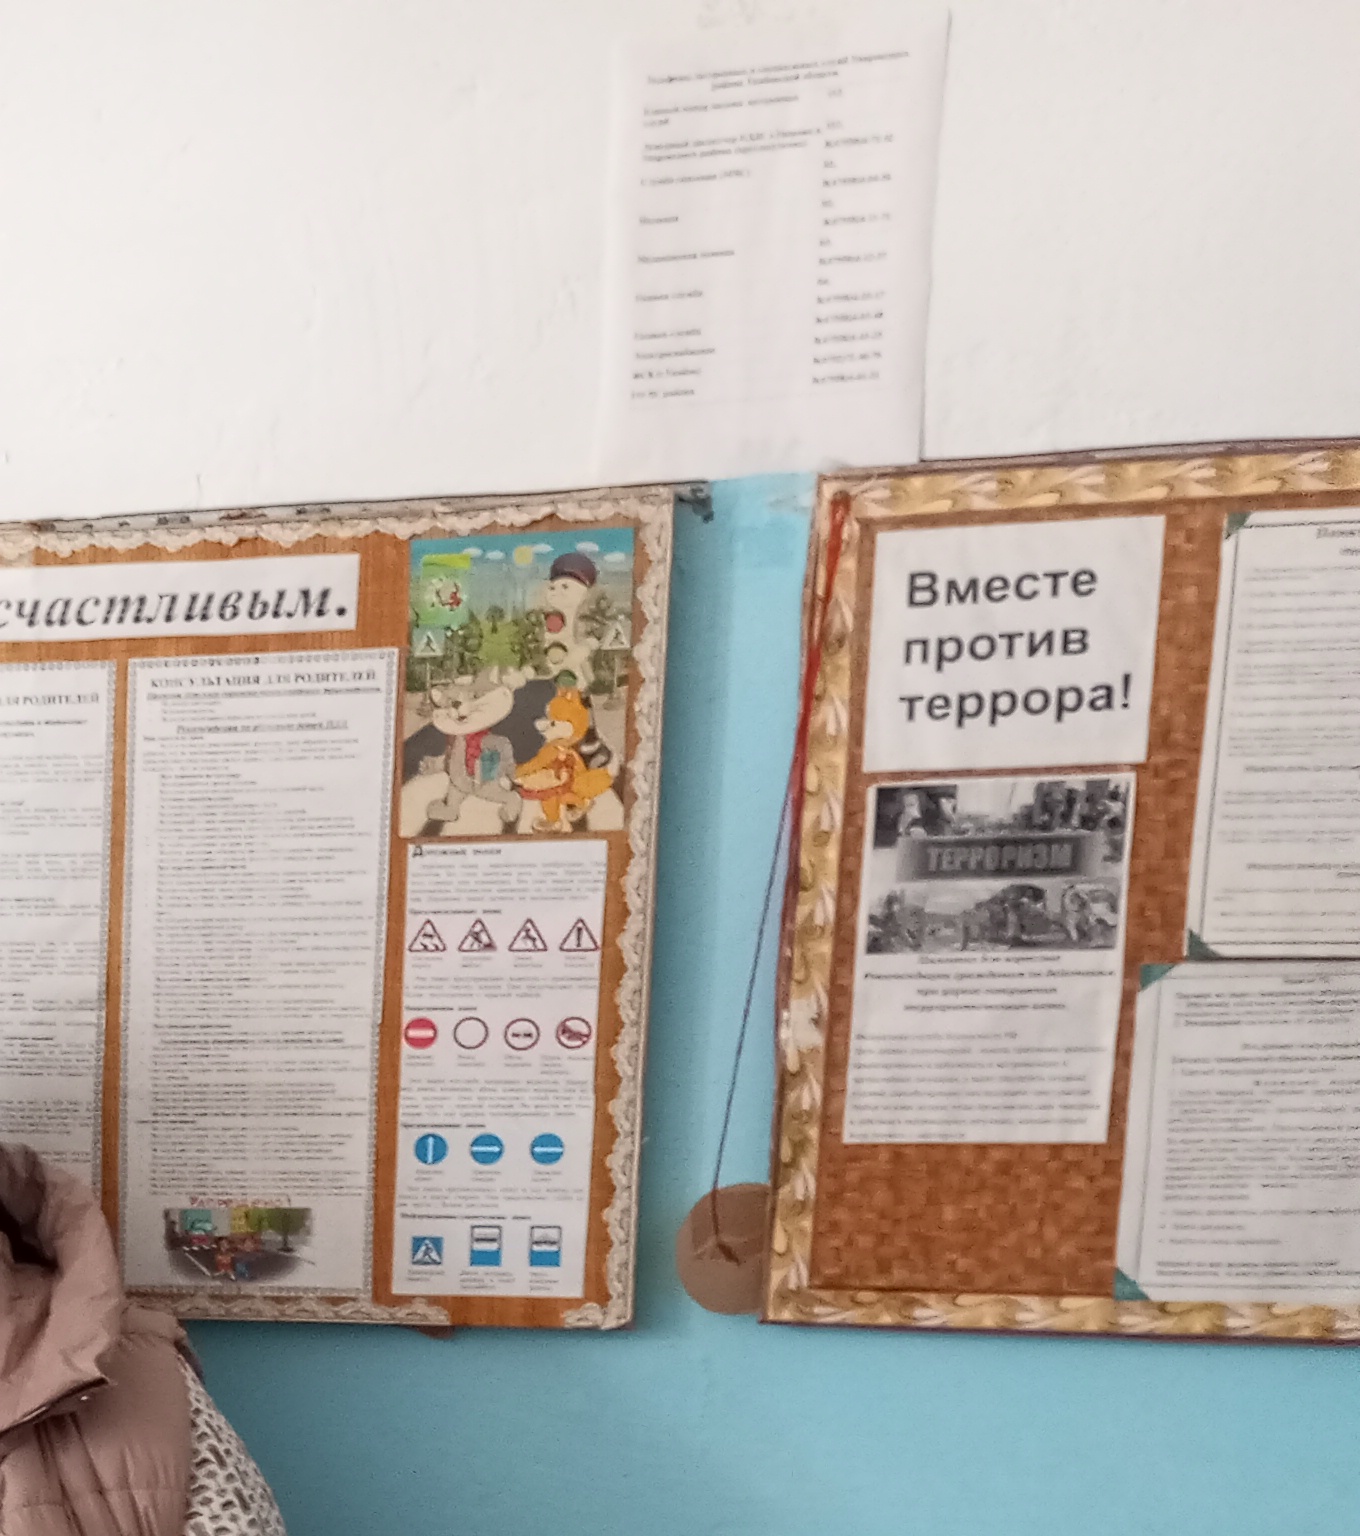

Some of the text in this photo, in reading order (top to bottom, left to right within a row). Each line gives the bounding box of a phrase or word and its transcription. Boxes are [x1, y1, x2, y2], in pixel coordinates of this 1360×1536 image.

[907, 567, 1099, 609] Вместе
[904, 626, 1090, 671] против
[899, 673, 1133, 729] террора!
[926, 842, 1075, 874] ТЕРРОРИЗМ
